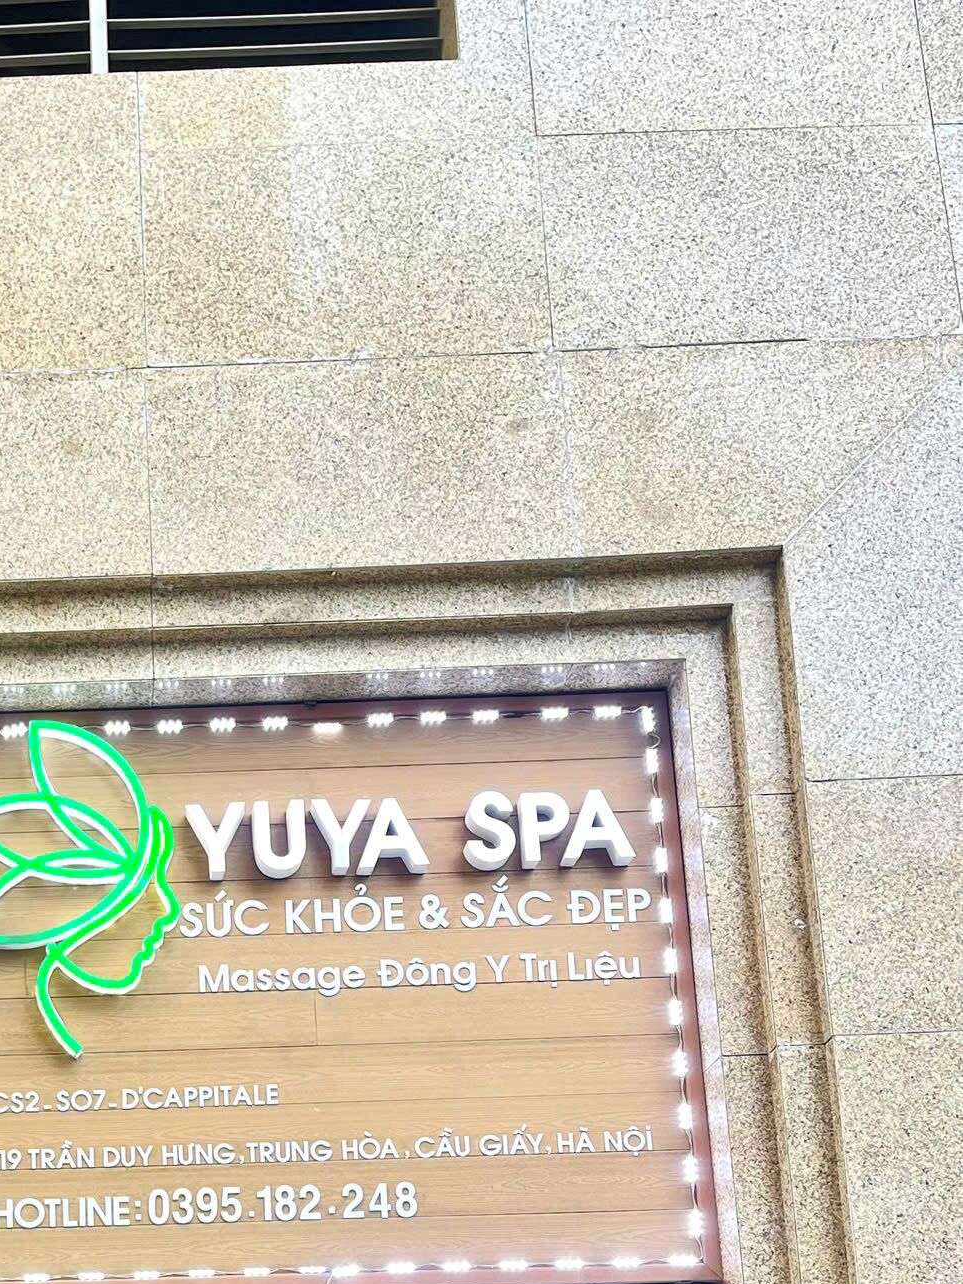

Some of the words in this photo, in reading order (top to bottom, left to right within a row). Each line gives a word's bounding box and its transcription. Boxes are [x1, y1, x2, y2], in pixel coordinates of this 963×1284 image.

[184, 797, 429, 881] YUYA
[463, 789, 636, 872] SPA
[179, 891, 270, 938] SỨC
[285, 884, 405, 935] KHỎE
[418, 894, 450, 930] &
[461, 875, 553, 929] SẮC
[567, 888, 651, 930] ĐẸP
[198, 964, 365, 996] Massage
[377, 958, 477, 991] Đông
[485, 955, 510, 983] Y
[519, 953, 558, 988] Trị
[568, 951, 641, 985] Liệu
[28, 1140, 95, 1169] TRẦN
[103, 1145, 153, 1168] DUY
[415, 1128, 470, 1158] CẦU
[557, 1127, 595, 1153] HÀ
[604, 1126, 653, 1156] NỘI
